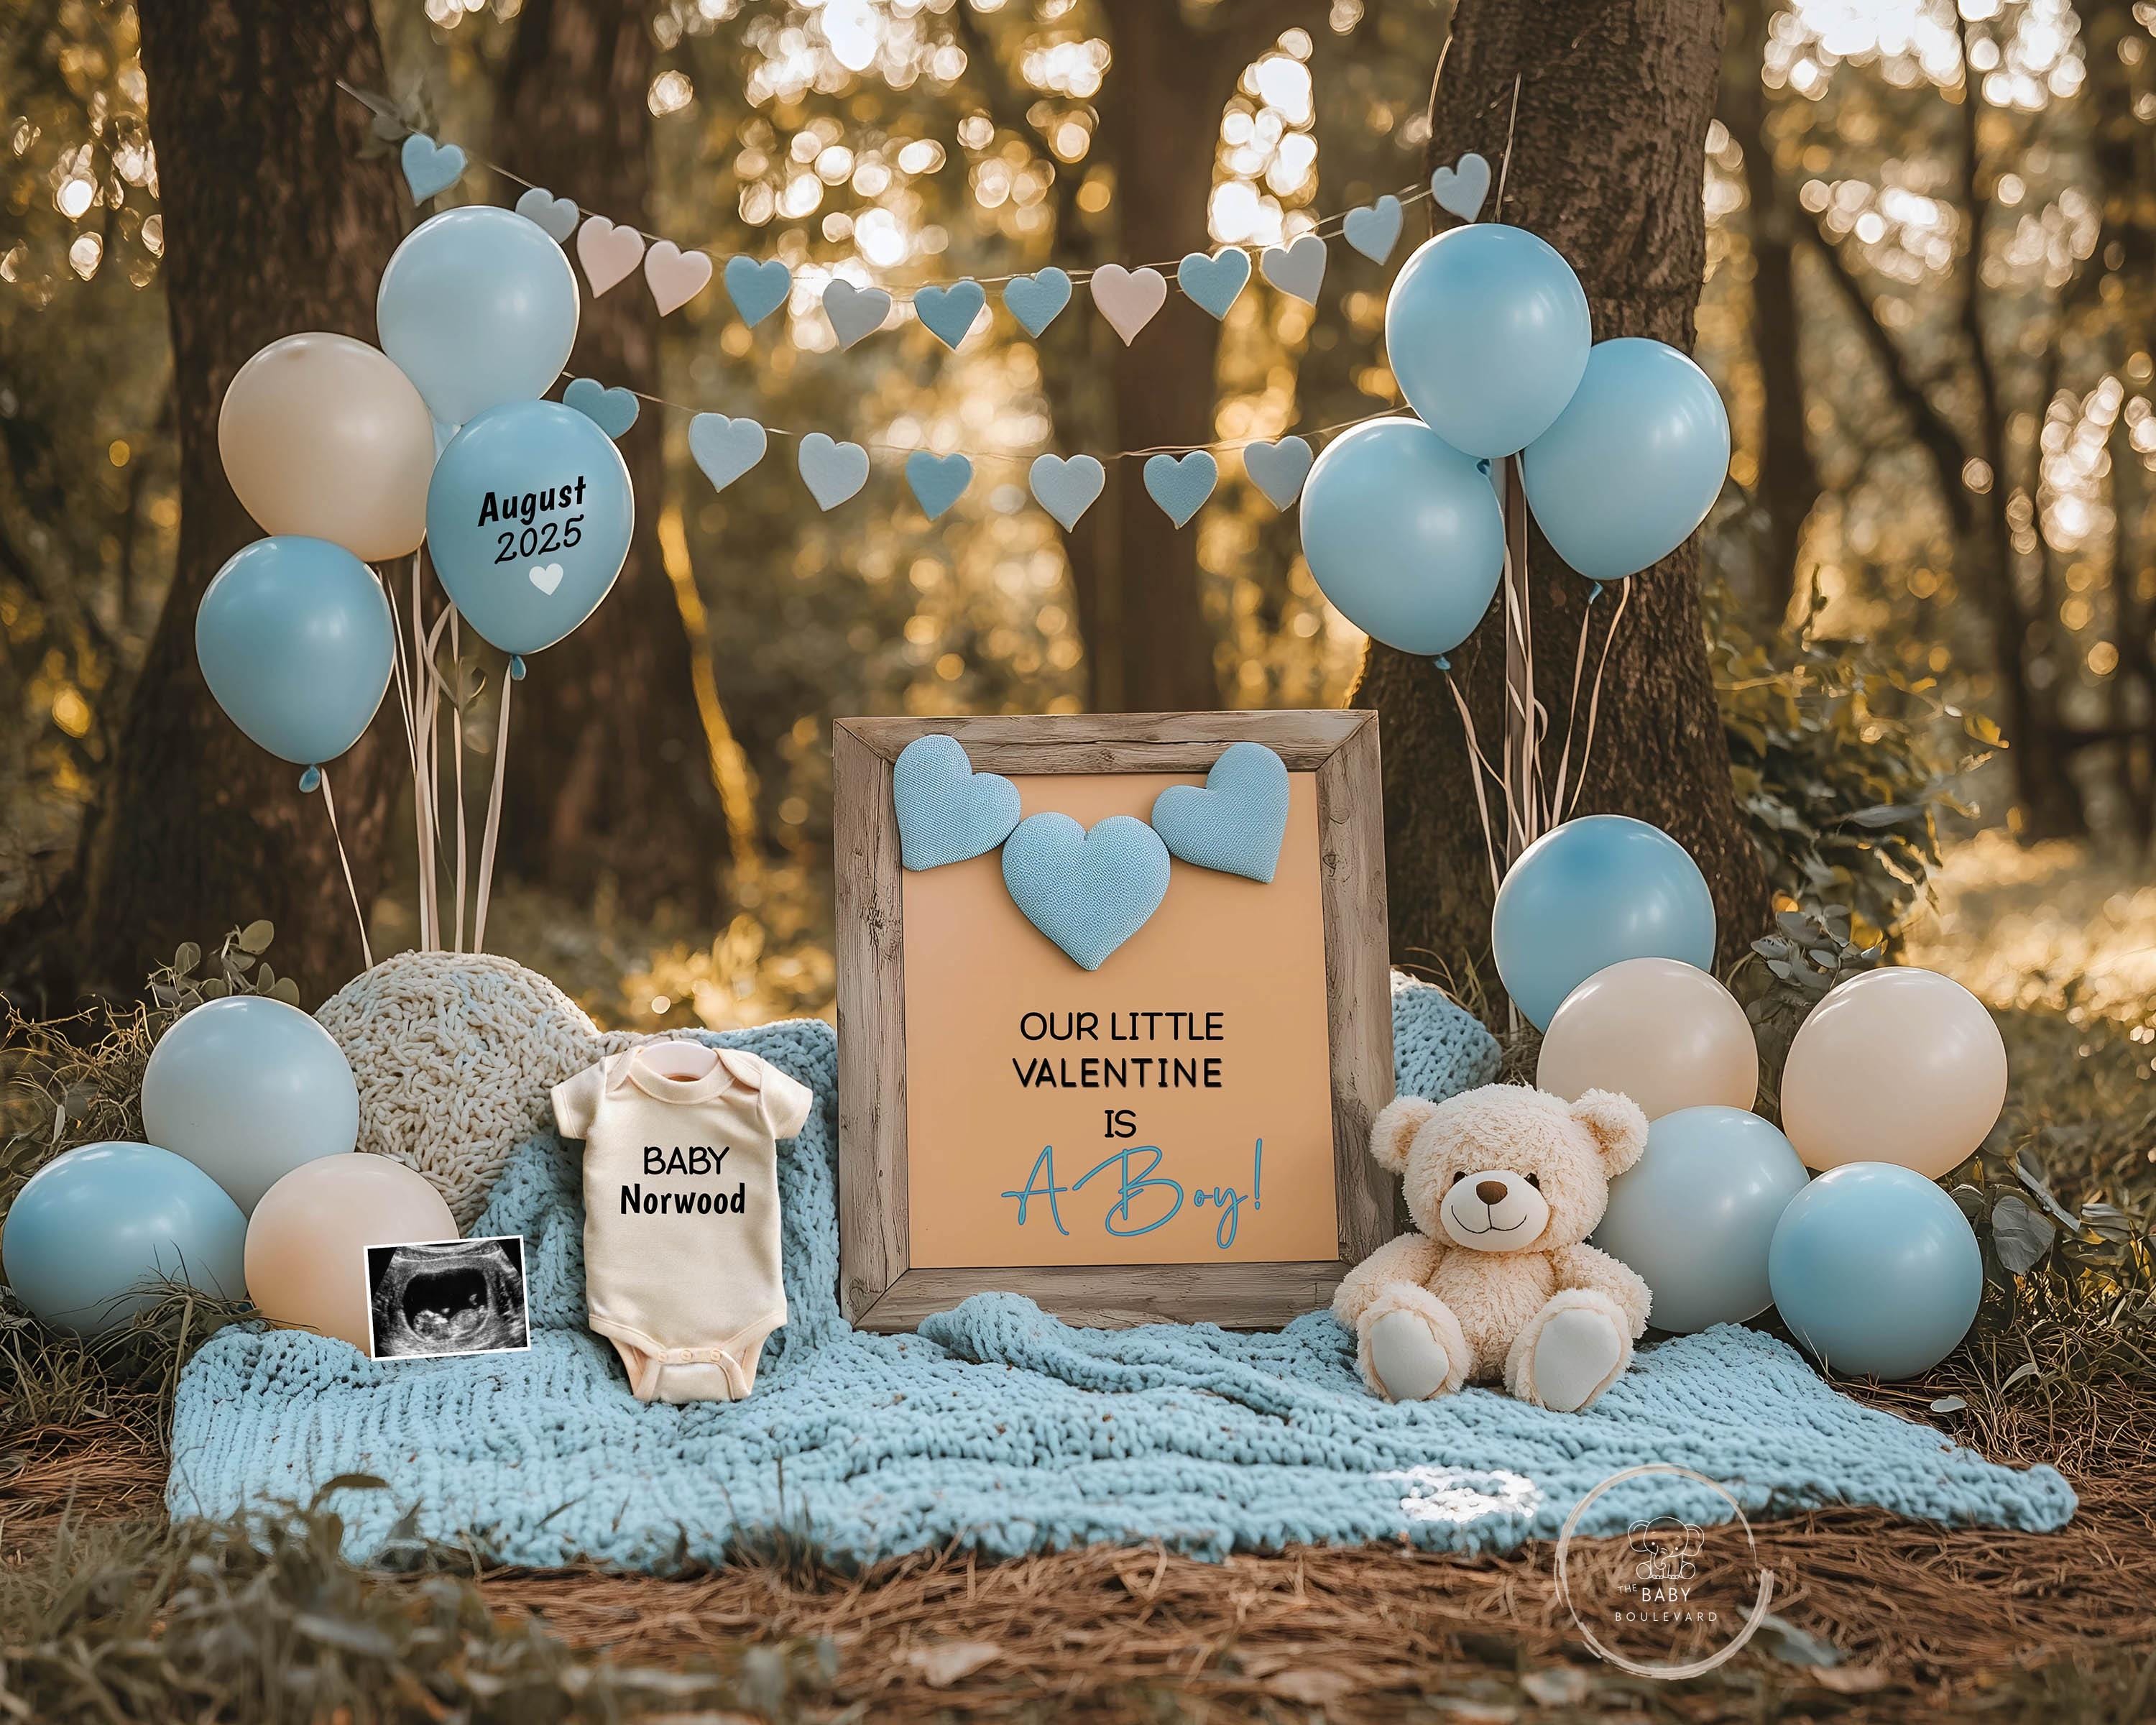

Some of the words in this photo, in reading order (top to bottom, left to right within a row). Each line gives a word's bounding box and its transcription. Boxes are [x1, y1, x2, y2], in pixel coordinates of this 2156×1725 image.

[477, 475, 586, 527] August
[494, 514, 584, 564] 2025
[1020, 1012, 1099, 1041] OUR
[1111, 1012, 1224, 1041] LITTLE
[1012, 1058, 1222, 1087] VALENTINE
[1104, 1109, 1137, 1138] IS
[643, 1146, 730, 1175] BABY
[620, 1182, 745, 1215] Norwood
[1001, 1145, 1069, 1236] A
[1072, 1138, 1263, 1249] Boy!
